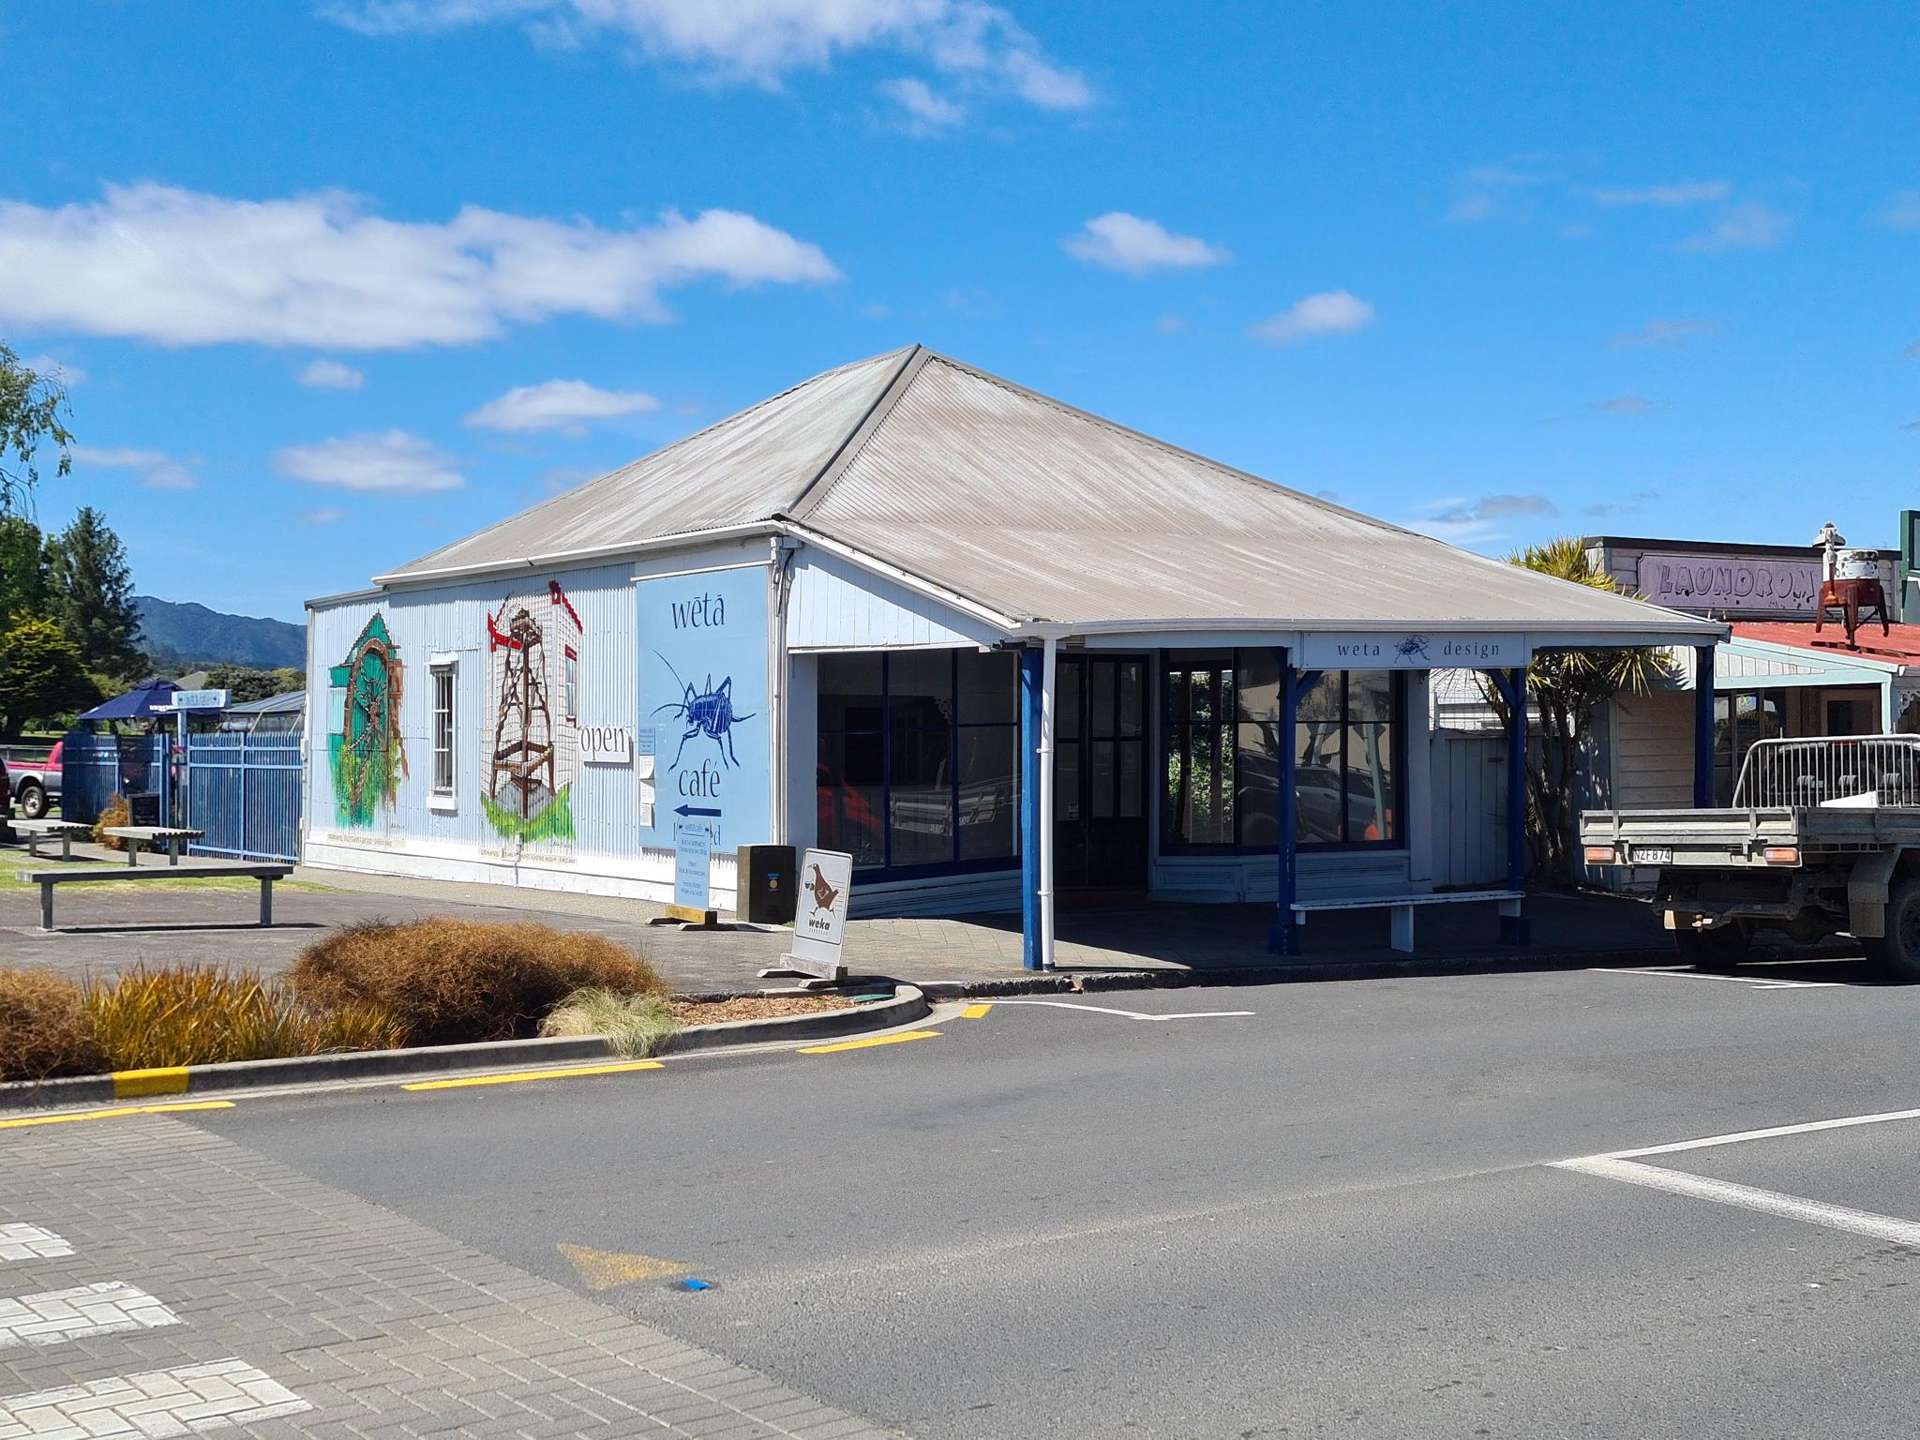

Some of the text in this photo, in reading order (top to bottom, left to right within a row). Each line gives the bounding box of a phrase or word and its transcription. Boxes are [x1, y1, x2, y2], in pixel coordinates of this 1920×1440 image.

[1659, 564, 1816, 599] LAUNDROM
[671, 591, 726, 629] wētā
[1337, 639, 1500, 659] weta design
[580, 726, 626, 761] open
[678, 758, 721, 798] café
[808, 917, 831, 931] weka
